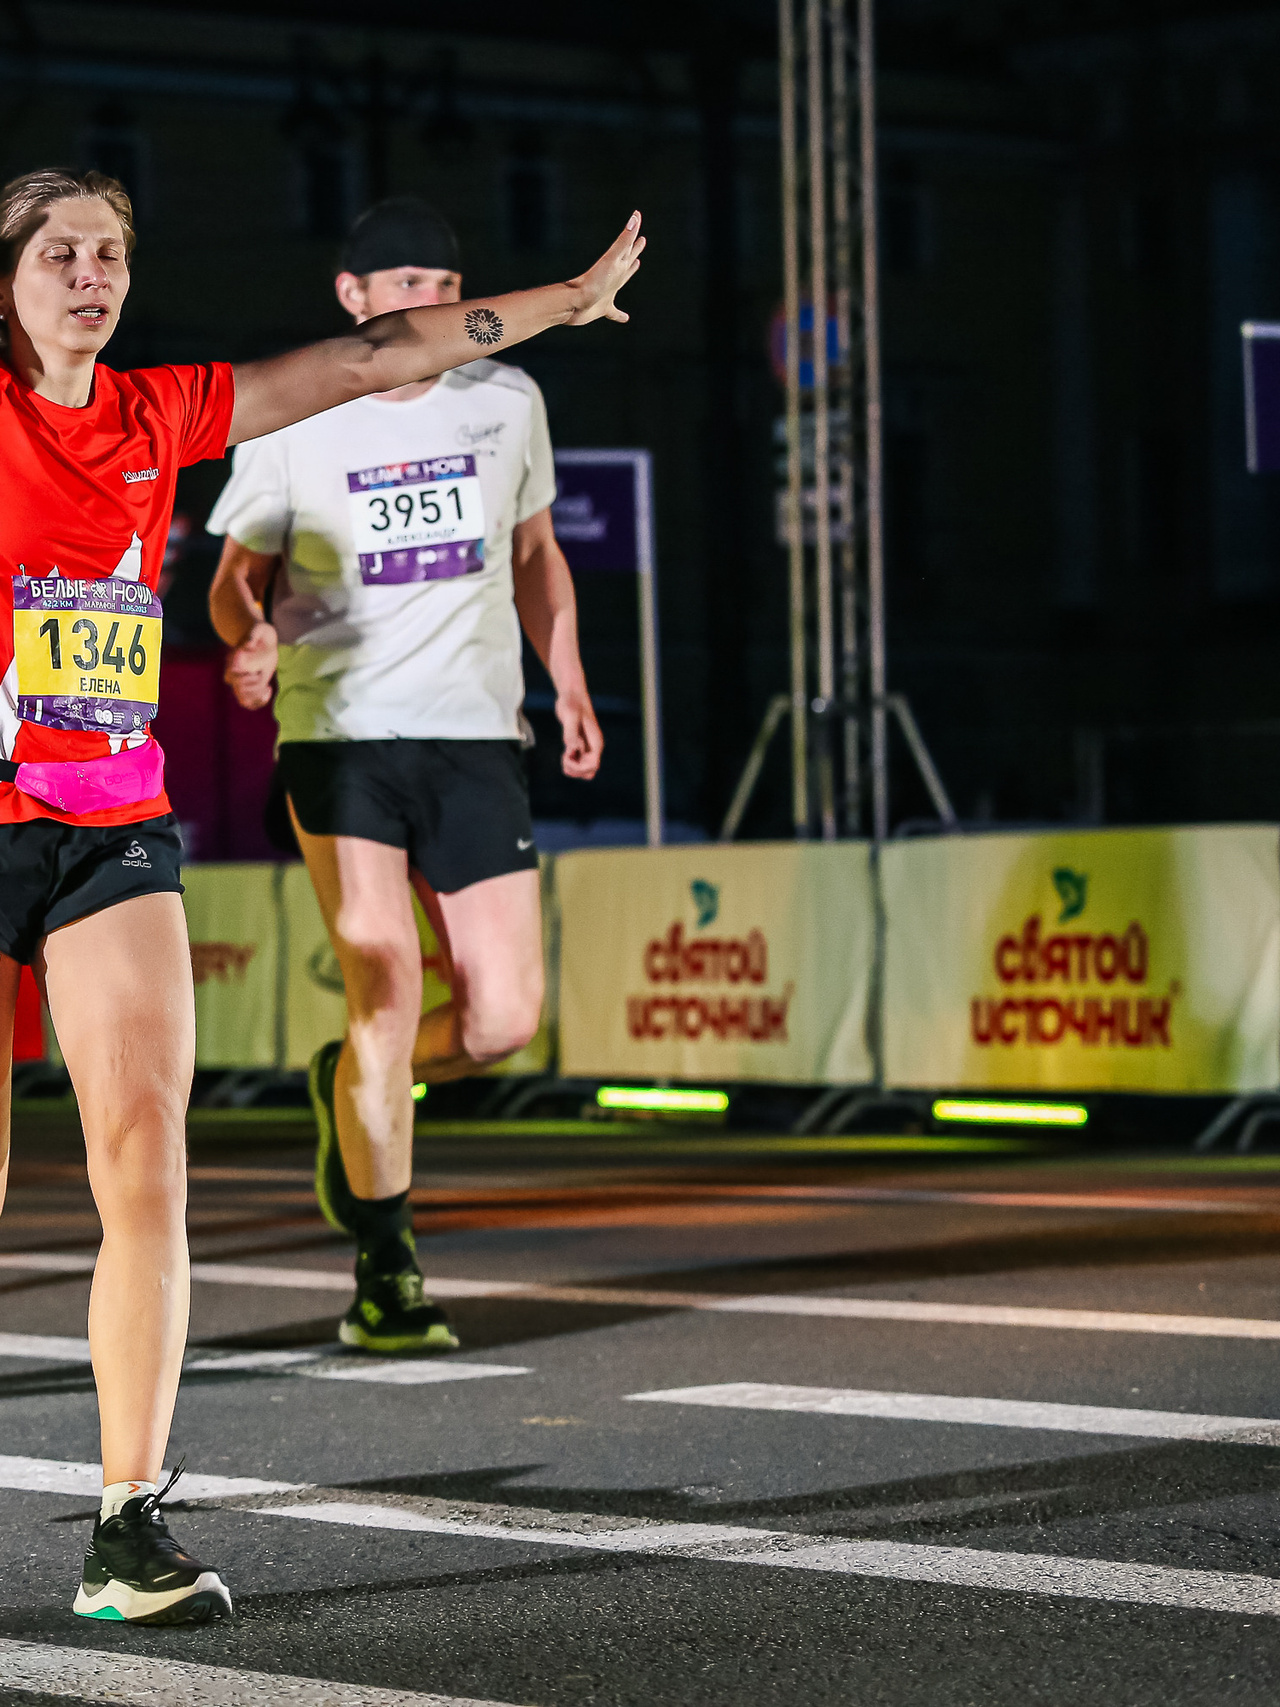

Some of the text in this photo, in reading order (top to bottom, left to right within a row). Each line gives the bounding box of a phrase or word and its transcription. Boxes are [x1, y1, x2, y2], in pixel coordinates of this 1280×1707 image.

[369, 487, 463, 531] 3951
[30, 579, 153, 605] БЕЛЫЕ НОЧИ
[39, 618, 146, 676] 1346
[80, 678, 121, 694] ЕЛЕНА
[122, 860, 151, 868] odlo
